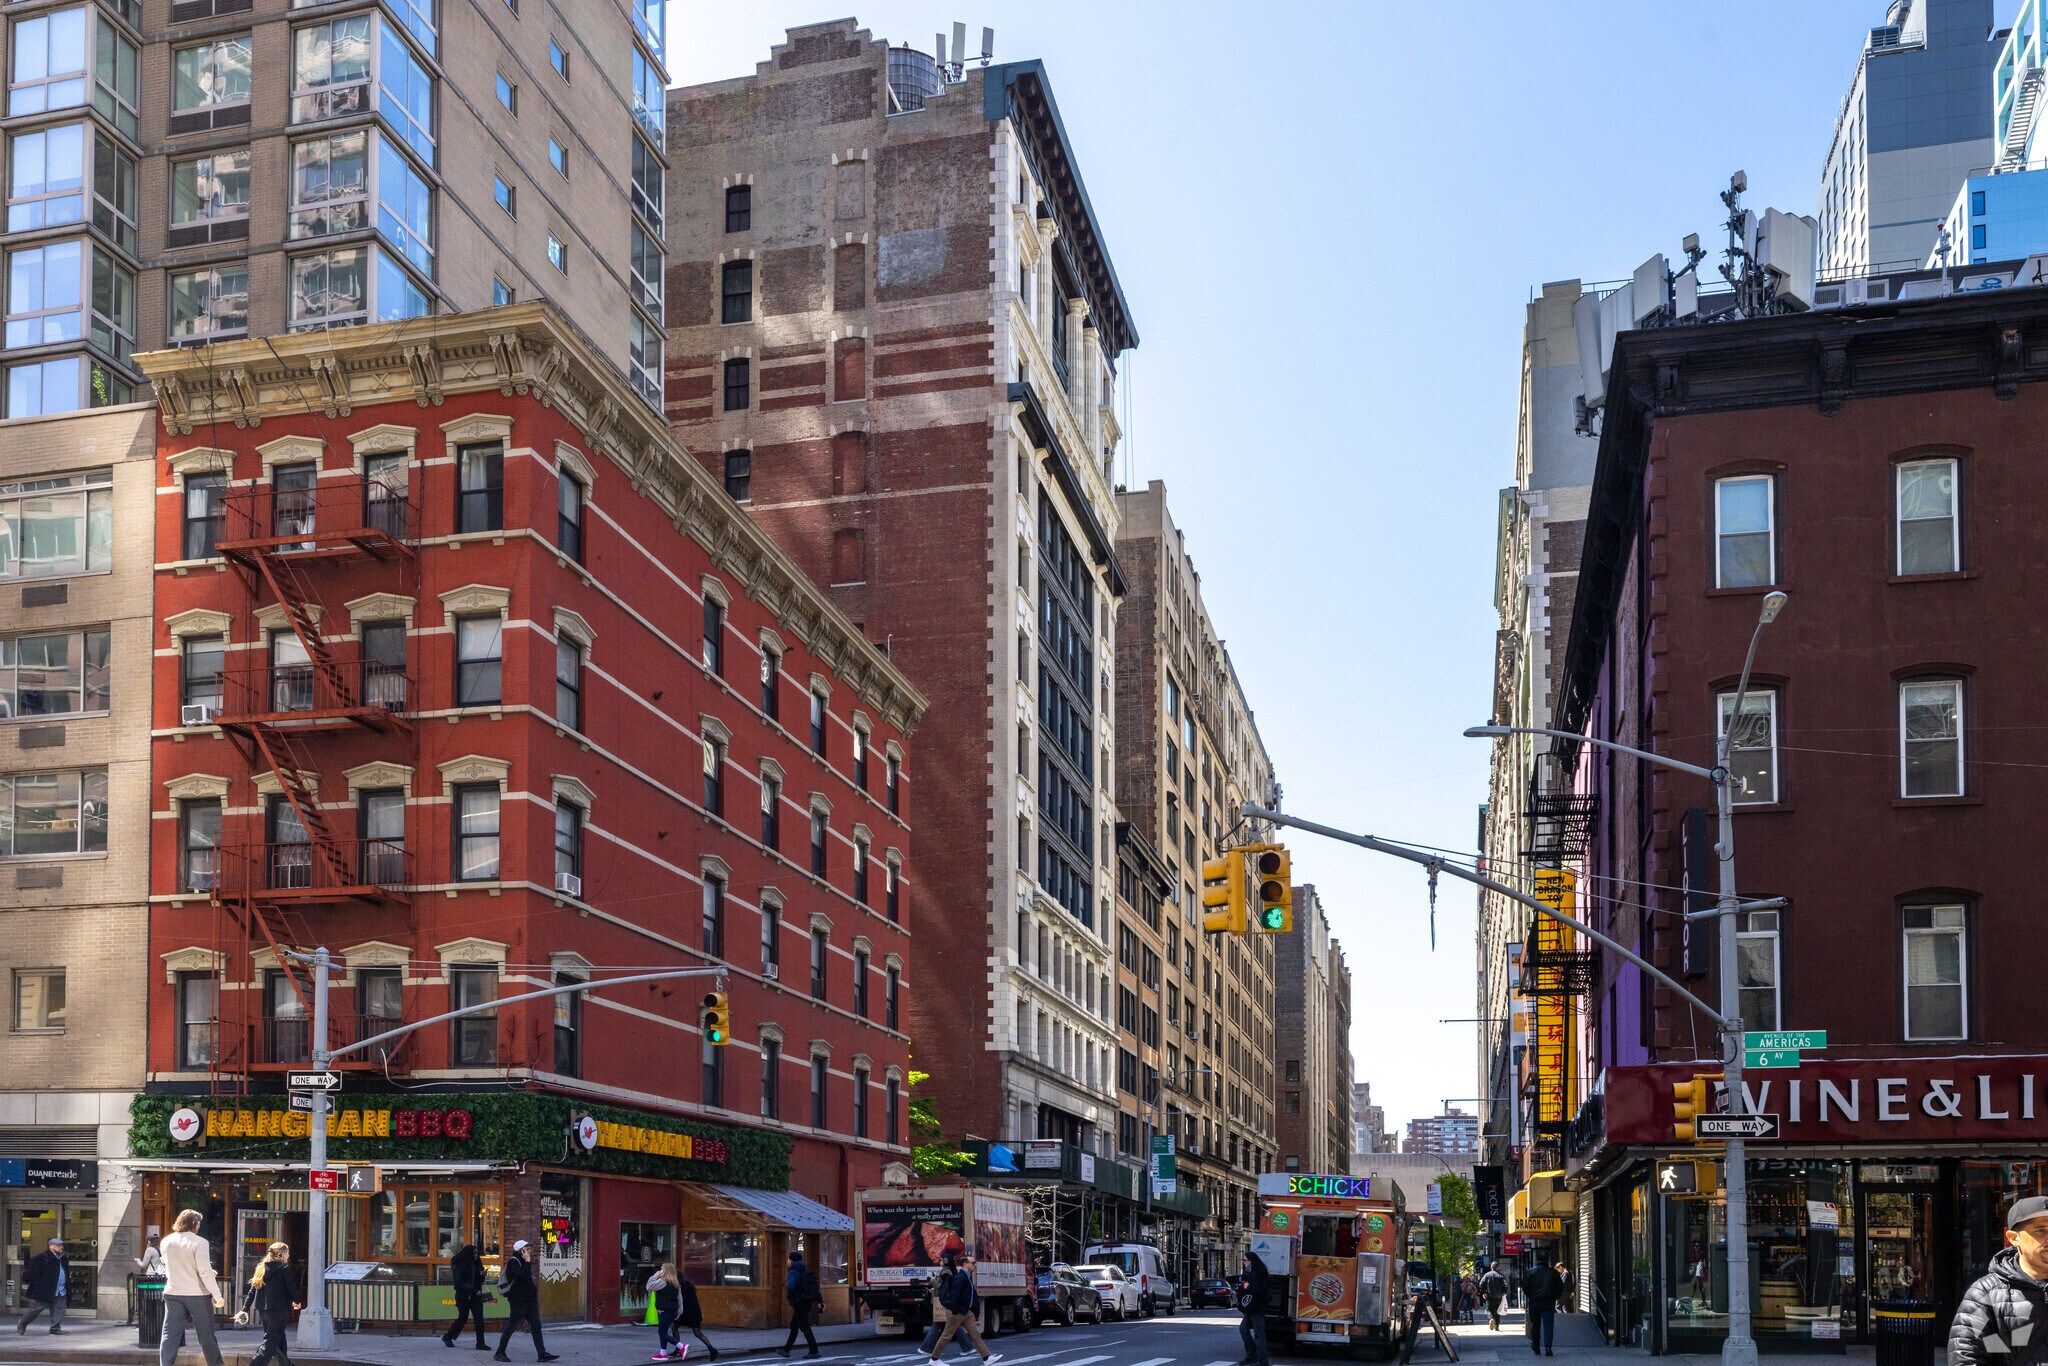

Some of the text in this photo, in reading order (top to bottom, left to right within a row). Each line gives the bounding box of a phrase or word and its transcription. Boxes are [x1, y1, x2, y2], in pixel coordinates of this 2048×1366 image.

[1546, 876, 1565, 885] NEW
[1538, 884, 1574, 894] DRAGON
[1547, 894, 1565, 903] TOY
[1682, 824, 1690, 973] LIQUOR
[1760, 1037, 1811, 1048] AMERICAS
[1759, 1053, 1768, 1066] 6
[295, 1076, 333, 1085] ONE WAY
[296, 1098, 309, 1107] ONE
[395, 1110, 473, 1140] BBQ
[1708, 1122, 1766, 1131] ONE WAY
[692, 1136, 727, 1166] BBQ
[1886, 1166, 1913, 1176] 795
[1488, 1184, 1499, 1216] FOCUS
[917, 1212, 931, 1220] really
[542, 1218, 569, 1232] Yes BBQ
[1515, 1219, 1555, 1230] DRAGON TOY
[547, 1232, 557, 1244] Yes
